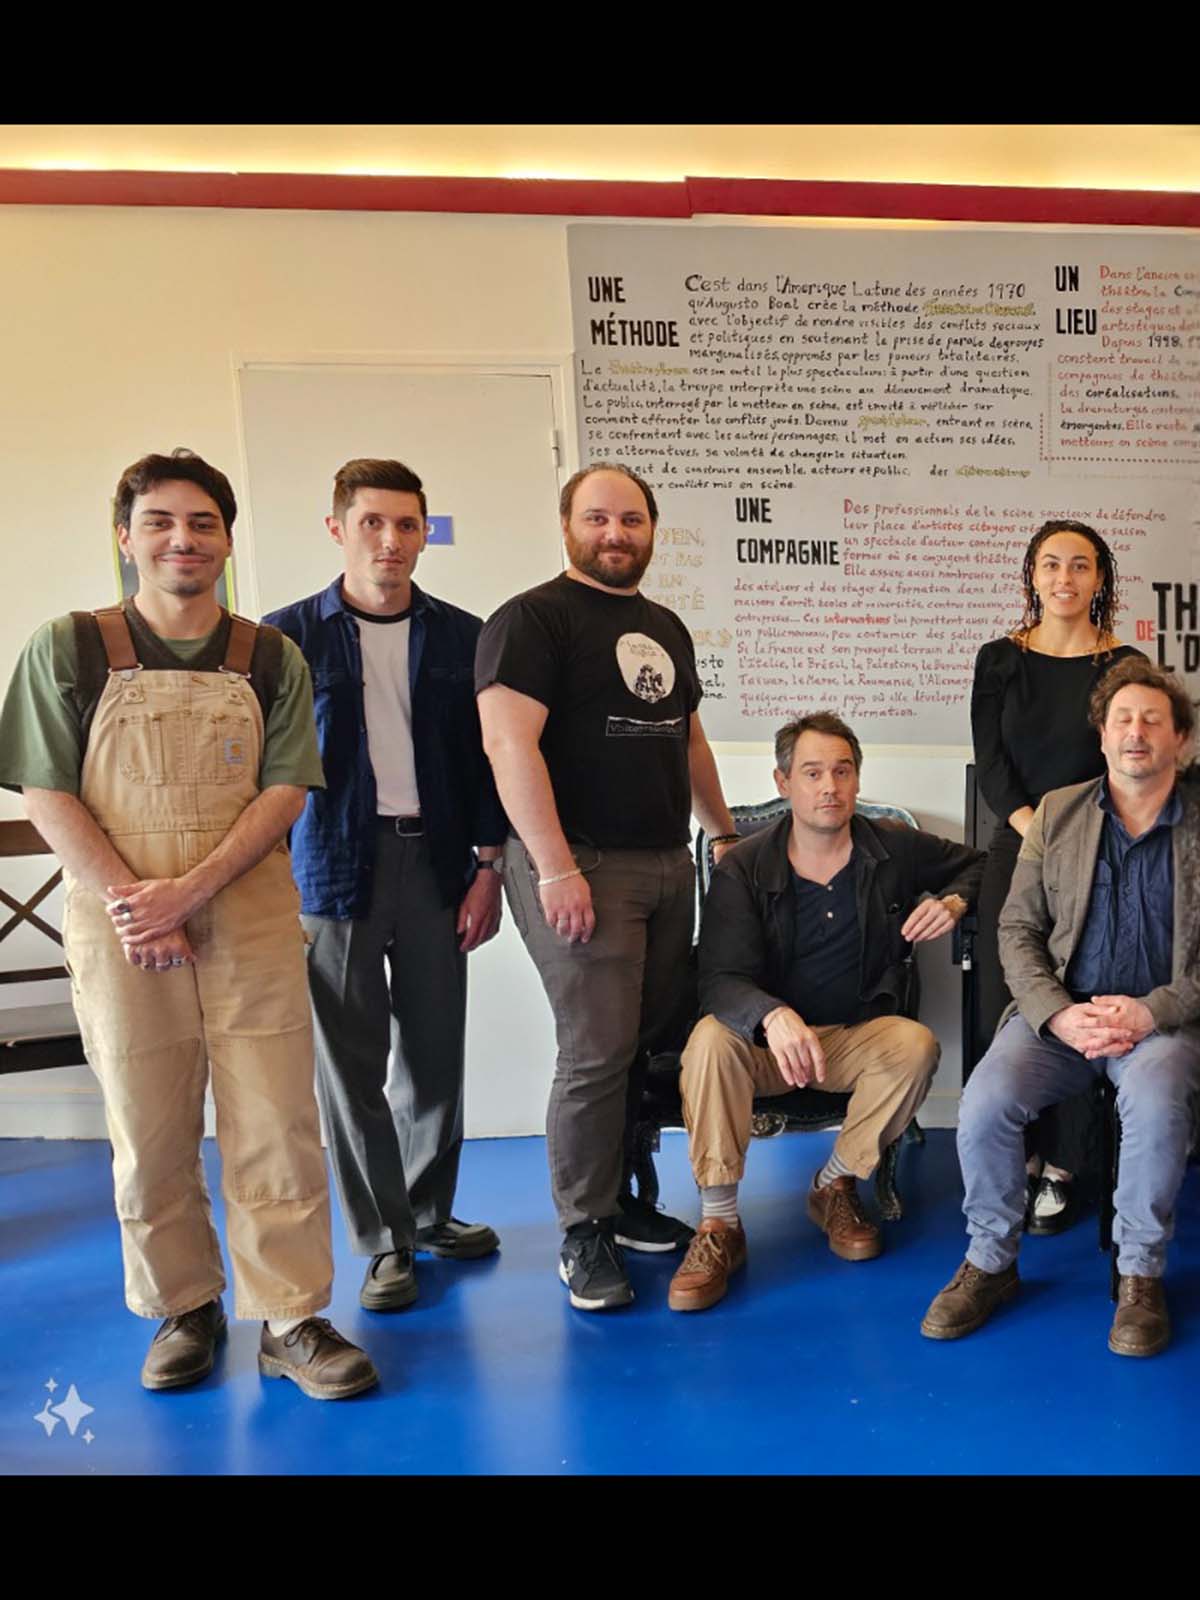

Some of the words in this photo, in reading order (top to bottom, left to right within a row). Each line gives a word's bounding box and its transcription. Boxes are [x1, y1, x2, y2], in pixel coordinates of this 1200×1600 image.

[1055, 265, 1080, 292] UN
[588, 276, 626, 303] UNE
[737, 277, 768, 292] dans
[905, 281, 926, 296] des
[932, 285, 979, 298] années
[769, 298, 800, 310] Boal
[862, 299, 919, 313] méthode
[689, 317, 718, 326] avec
[813, 315, 855, 327] rendre
[914, 316, 932, 329] des
[1056, 308, 1097, 336] LIEU
[591, 312, 680, 347] MÉTHODE
[689, 332, 702, 343] et
[779, 335, 794, 343] en
[838, 351, 857, 366] par
[864, 350, 880, 361] les
[704, 399, 723, 413] par
[846, 399, 864, 411] est
[974, 402, 994, 410] sur
[584, 415, 638, 425] comment
[686, 430, 711, 440] avec
[863, 432, 886, 443] met
[895, 435, 909, 443] en
[959, 434, 977, 444] ses
[662, 463, 677, 474] de
[929, 464, 949, 476] des
[739, 481, 753, 489] en
[735, 497, 772, 523] UNE
[844, 498, 869, 514] Des
[966, 503, 980, 516] de
[844, 537, 858, 547] un
[736, 538, 841, 566] COMPAGNIE
[844, 564, 867, 576] Elle
[820, 581, 836, 592] des
[926, 629, 944, 640] des
[951, 629, 983, 641] salles
[1136, 620, 1156, 642] DE
[832, 645, 850, 654] son
